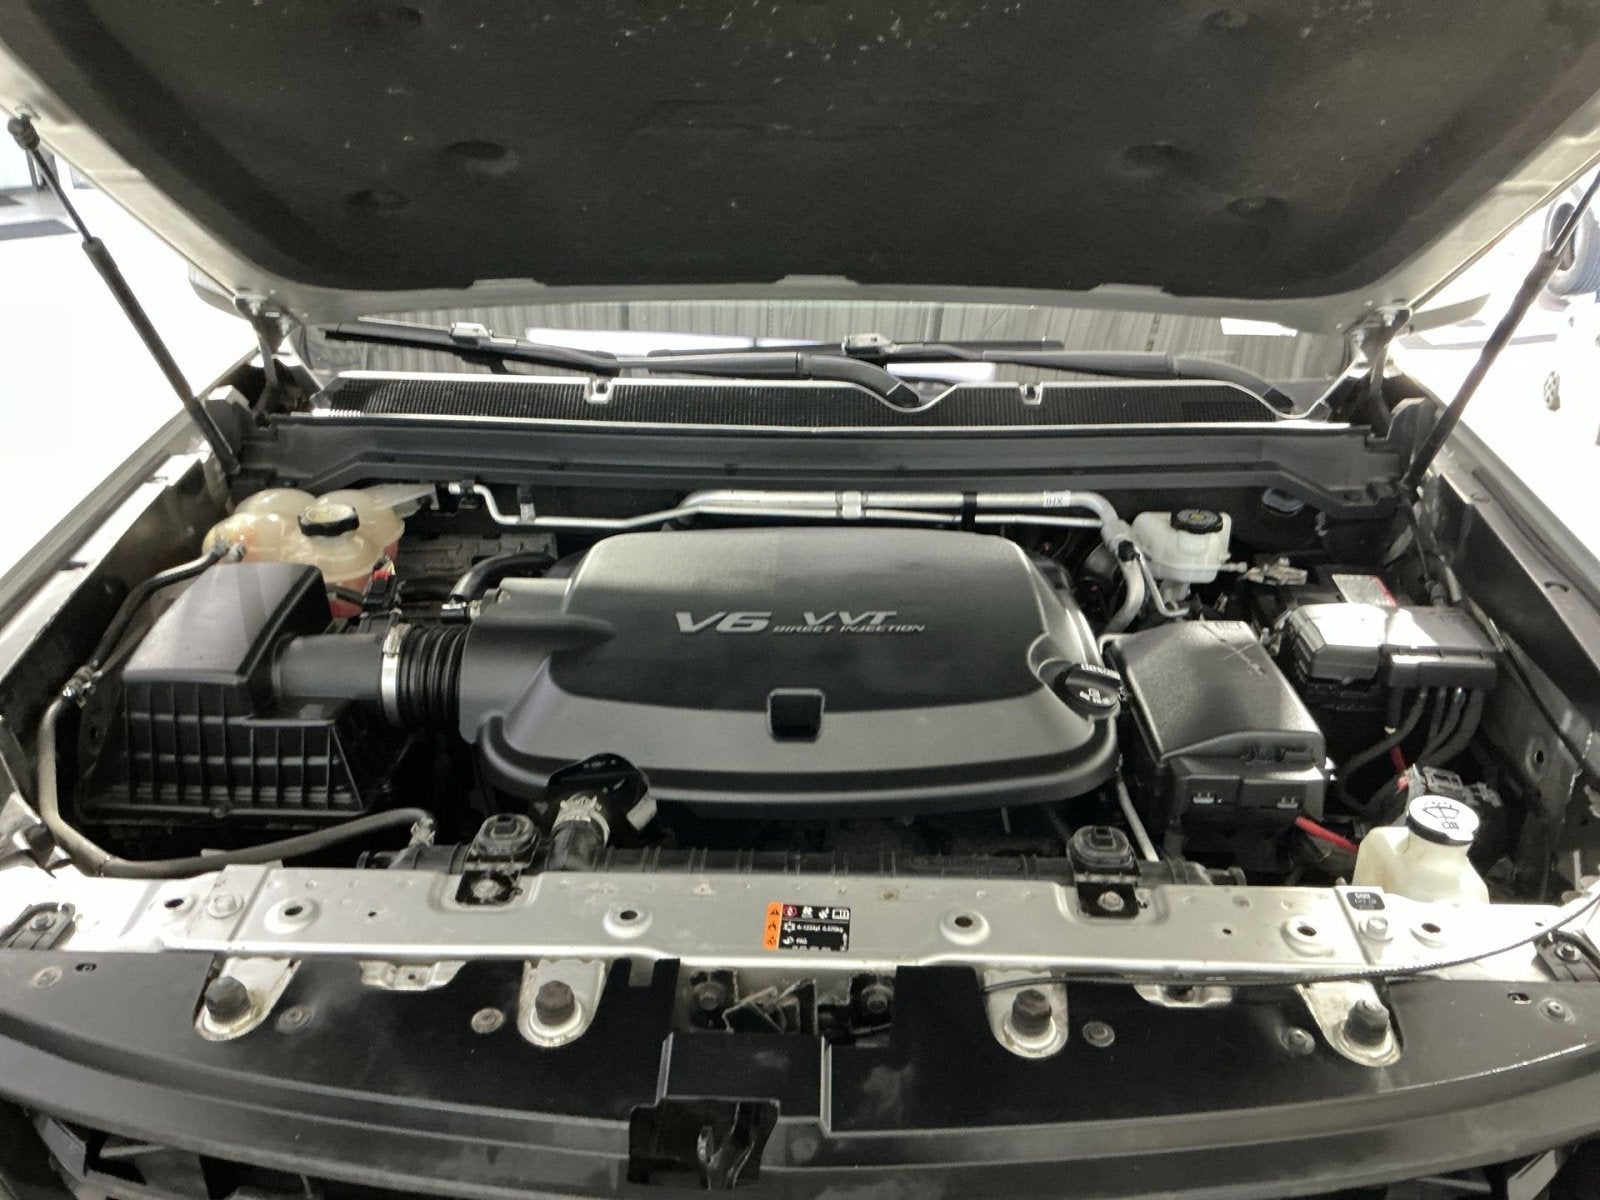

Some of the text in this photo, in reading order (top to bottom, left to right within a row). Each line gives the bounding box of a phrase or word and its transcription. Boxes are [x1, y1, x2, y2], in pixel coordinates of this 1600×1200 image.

[676, 611, 897, 633] V6 VVT
[772, 624, 925, 633] DIRECT INJECTION
